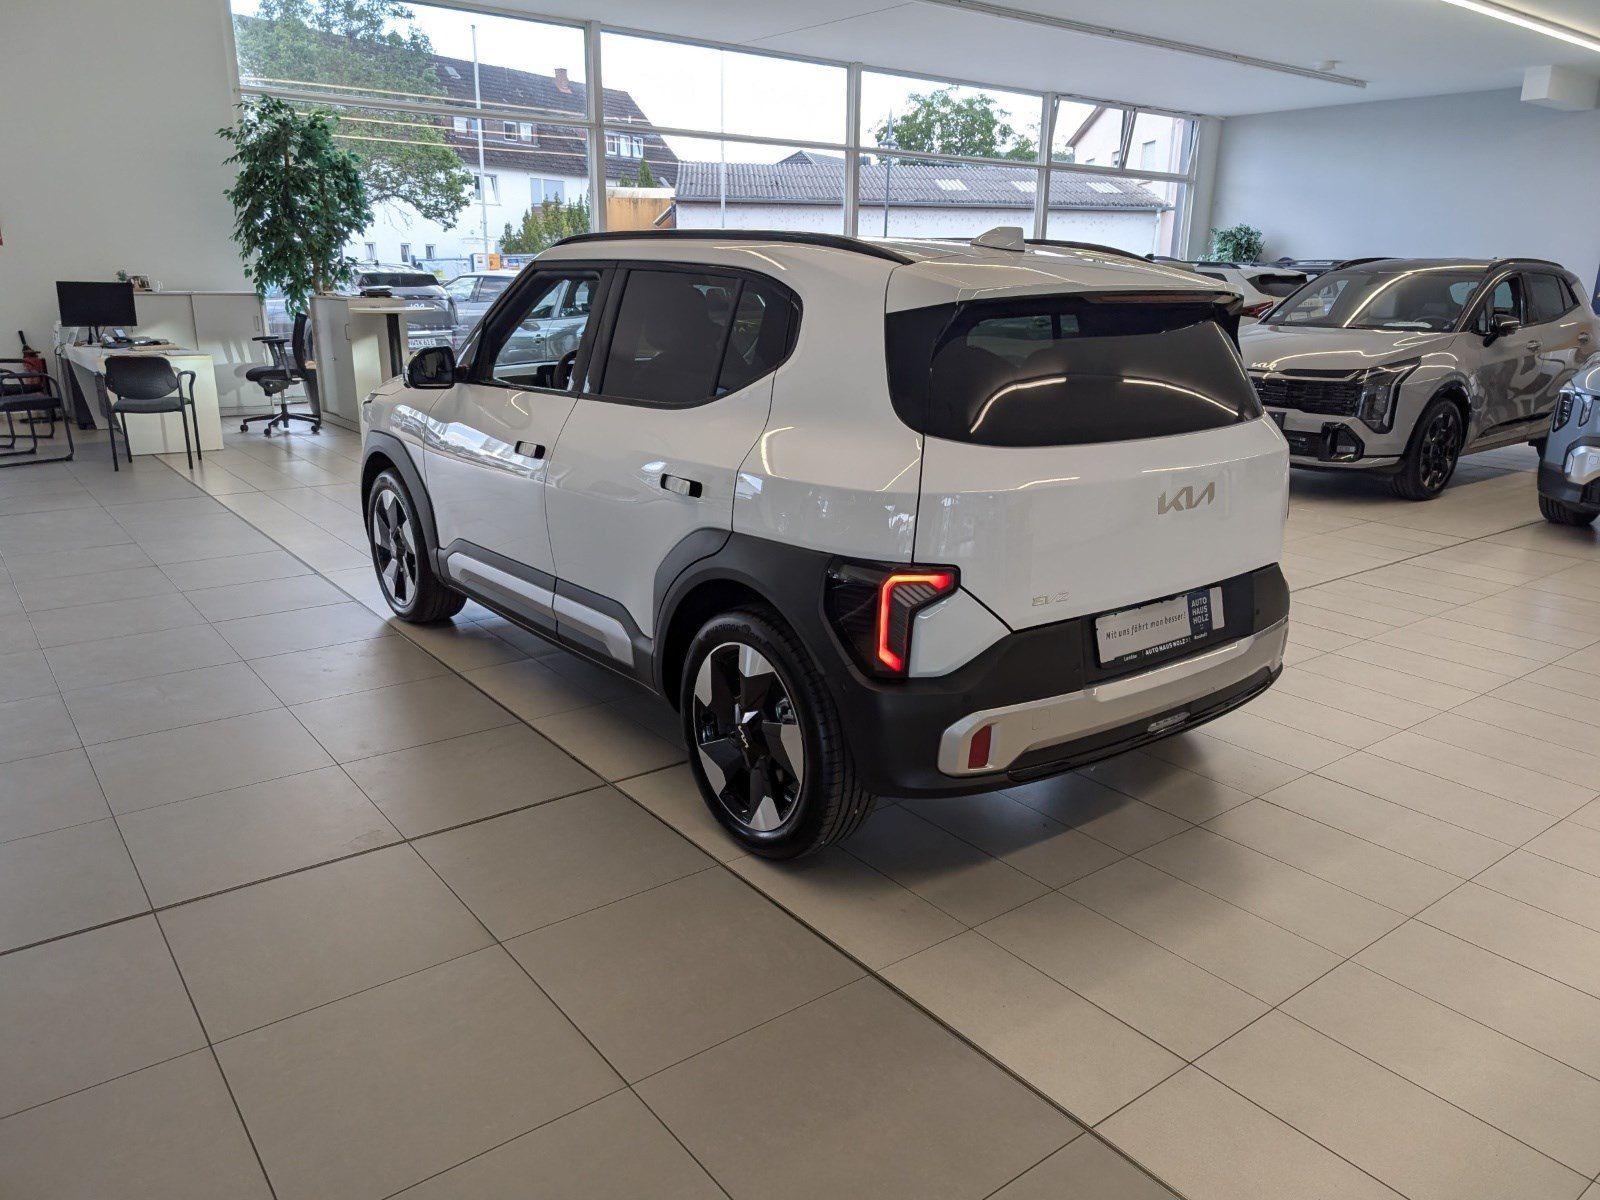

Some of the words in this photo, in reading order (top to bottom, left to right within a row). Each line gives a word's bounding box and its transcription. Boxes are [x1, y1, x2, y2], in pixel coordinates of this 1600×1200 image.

[1158, 481, 1215, 515] KIA
[1191, 596, 1208, 608] AUTO
[1192, 605, 1208, 616] HAUS
[1193, 614, 1210, 625] HOLZ
[1105, 630, 1117, 640] Mit
[1118, 628, 1130, 637] uns
[1150, 619, 1163, 629] man
[1164, 612, 1186, 625] besser!
